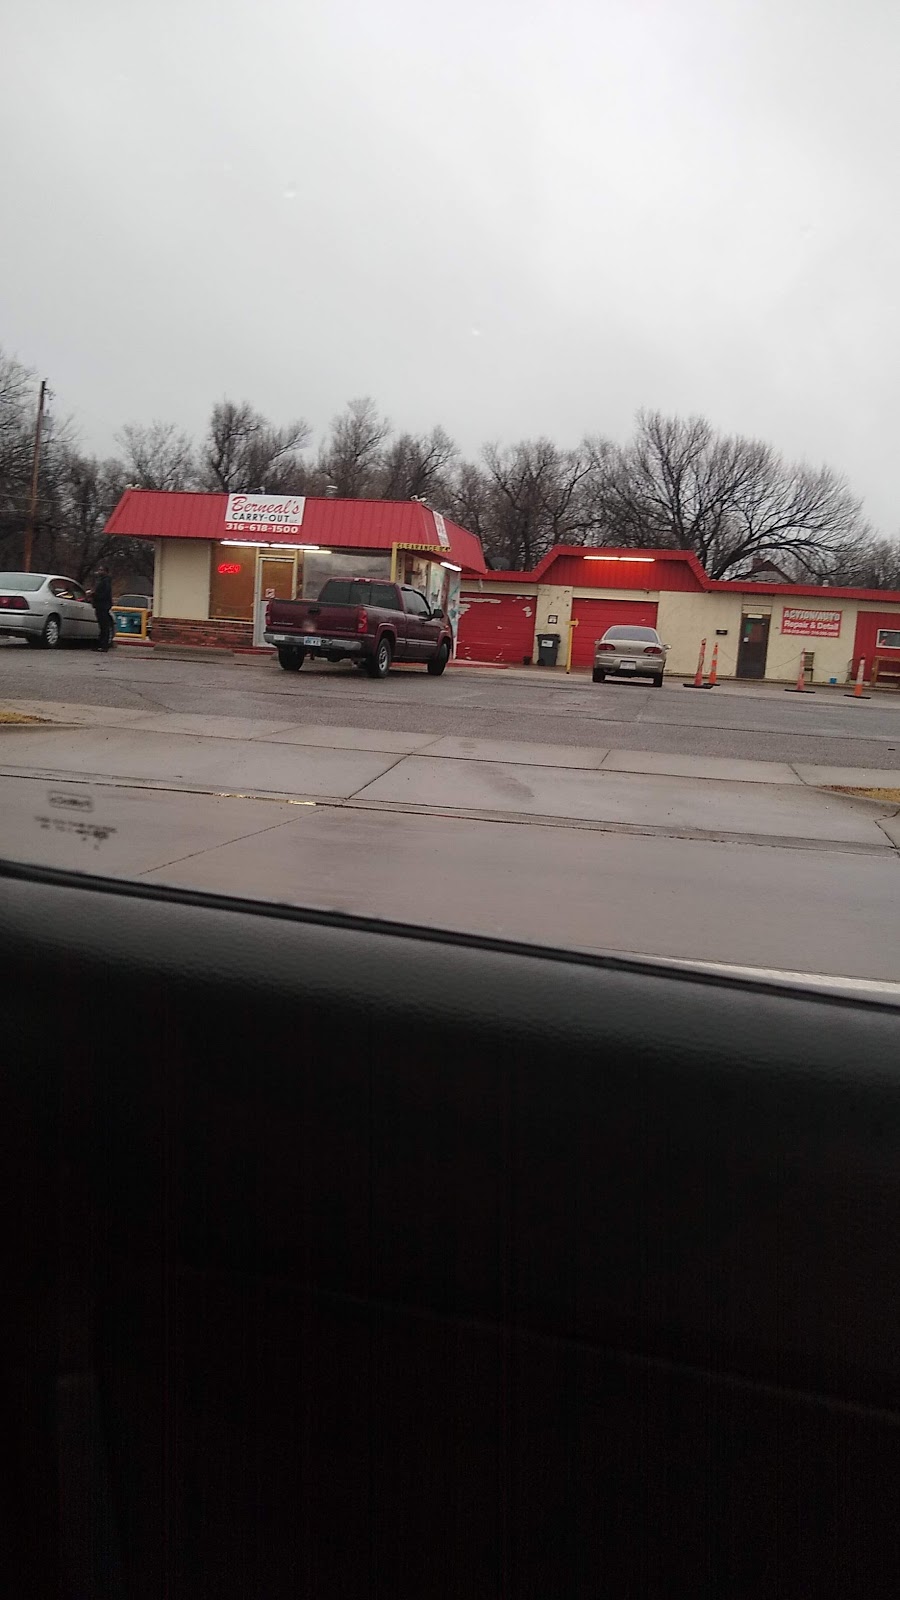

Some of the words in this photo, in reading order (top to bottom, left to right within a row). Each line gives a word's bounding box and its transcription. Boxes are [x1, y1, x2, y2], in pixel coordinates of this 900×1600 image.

[232, 496, 299, 514] Berneal's
[232, 513, 289, 522] CARRY-OUT
[226, 523, 298, 533] 316-618-1500
[784, 620, 809, 629] Repair
